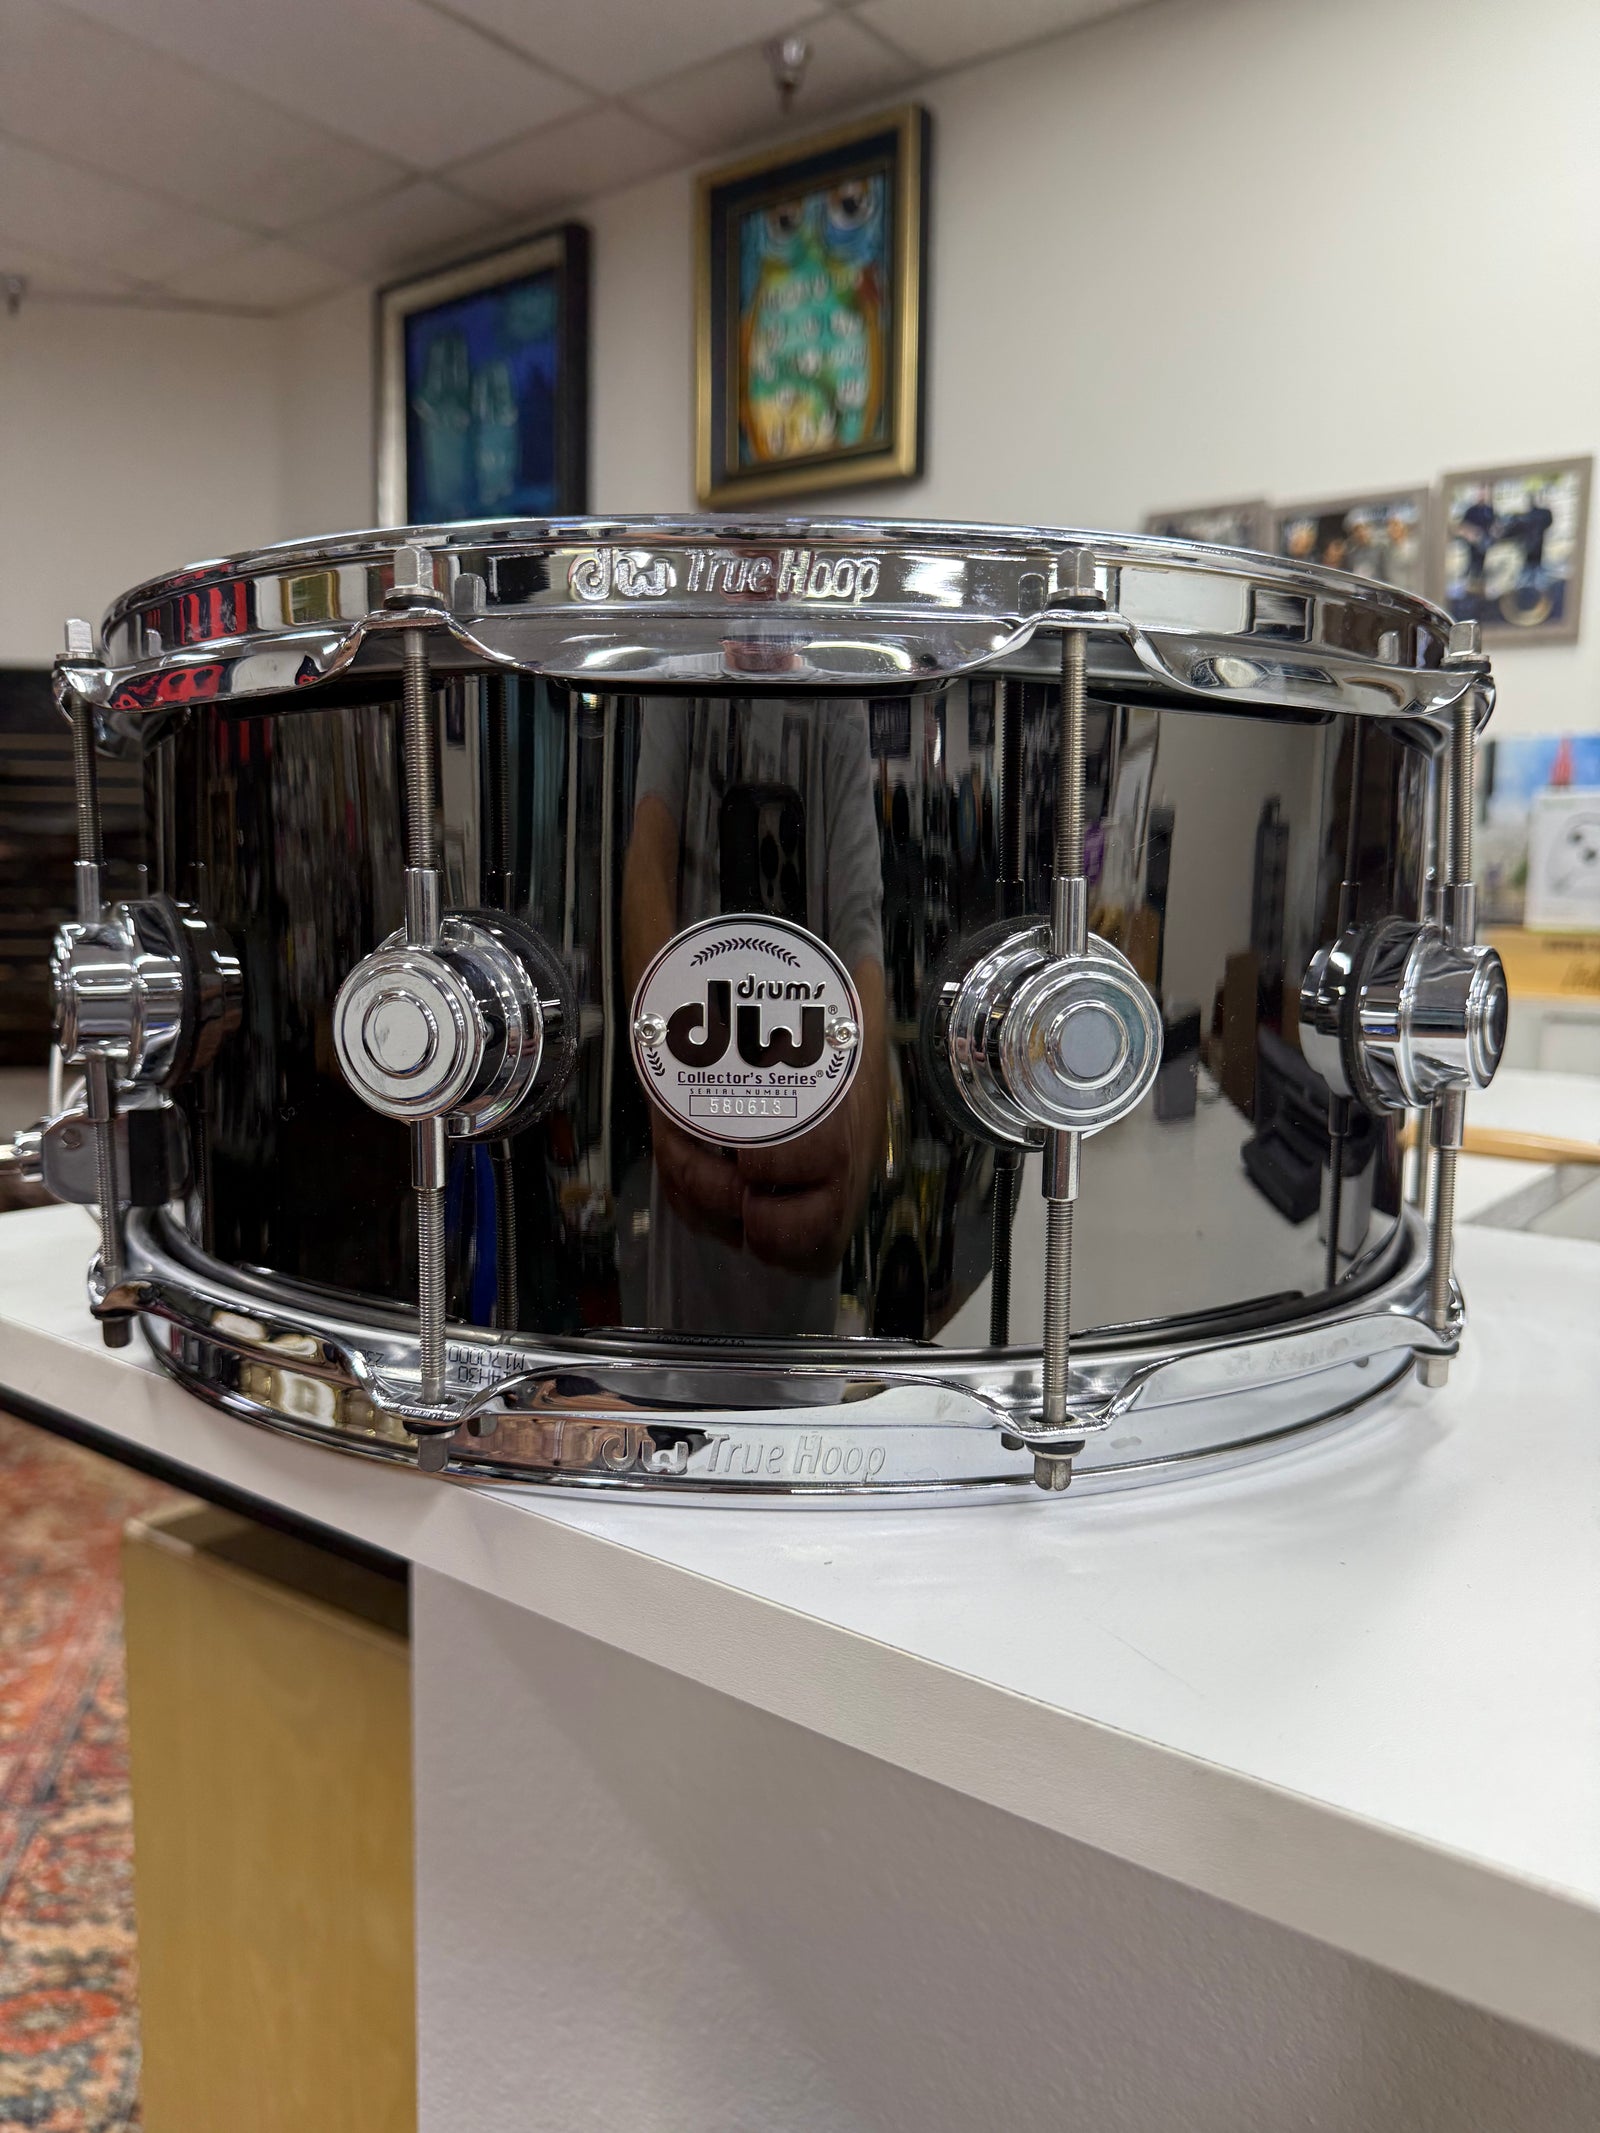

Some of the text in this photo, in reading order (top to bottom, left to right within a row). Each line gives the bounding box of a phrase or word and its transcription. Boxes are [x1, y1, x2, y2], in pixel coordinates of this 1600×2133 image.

[569, 548, 881, 605] dw True Hoop
[737, 973, 826, 1000] drums
[677, 1071, 762, 1085] Collector's
[689, 1088, 798, 1097] SERIAL NUMBER
[710, 1097, 782, 1115] 580613
[601, 1427, 887, 1484] dw True Hoop
